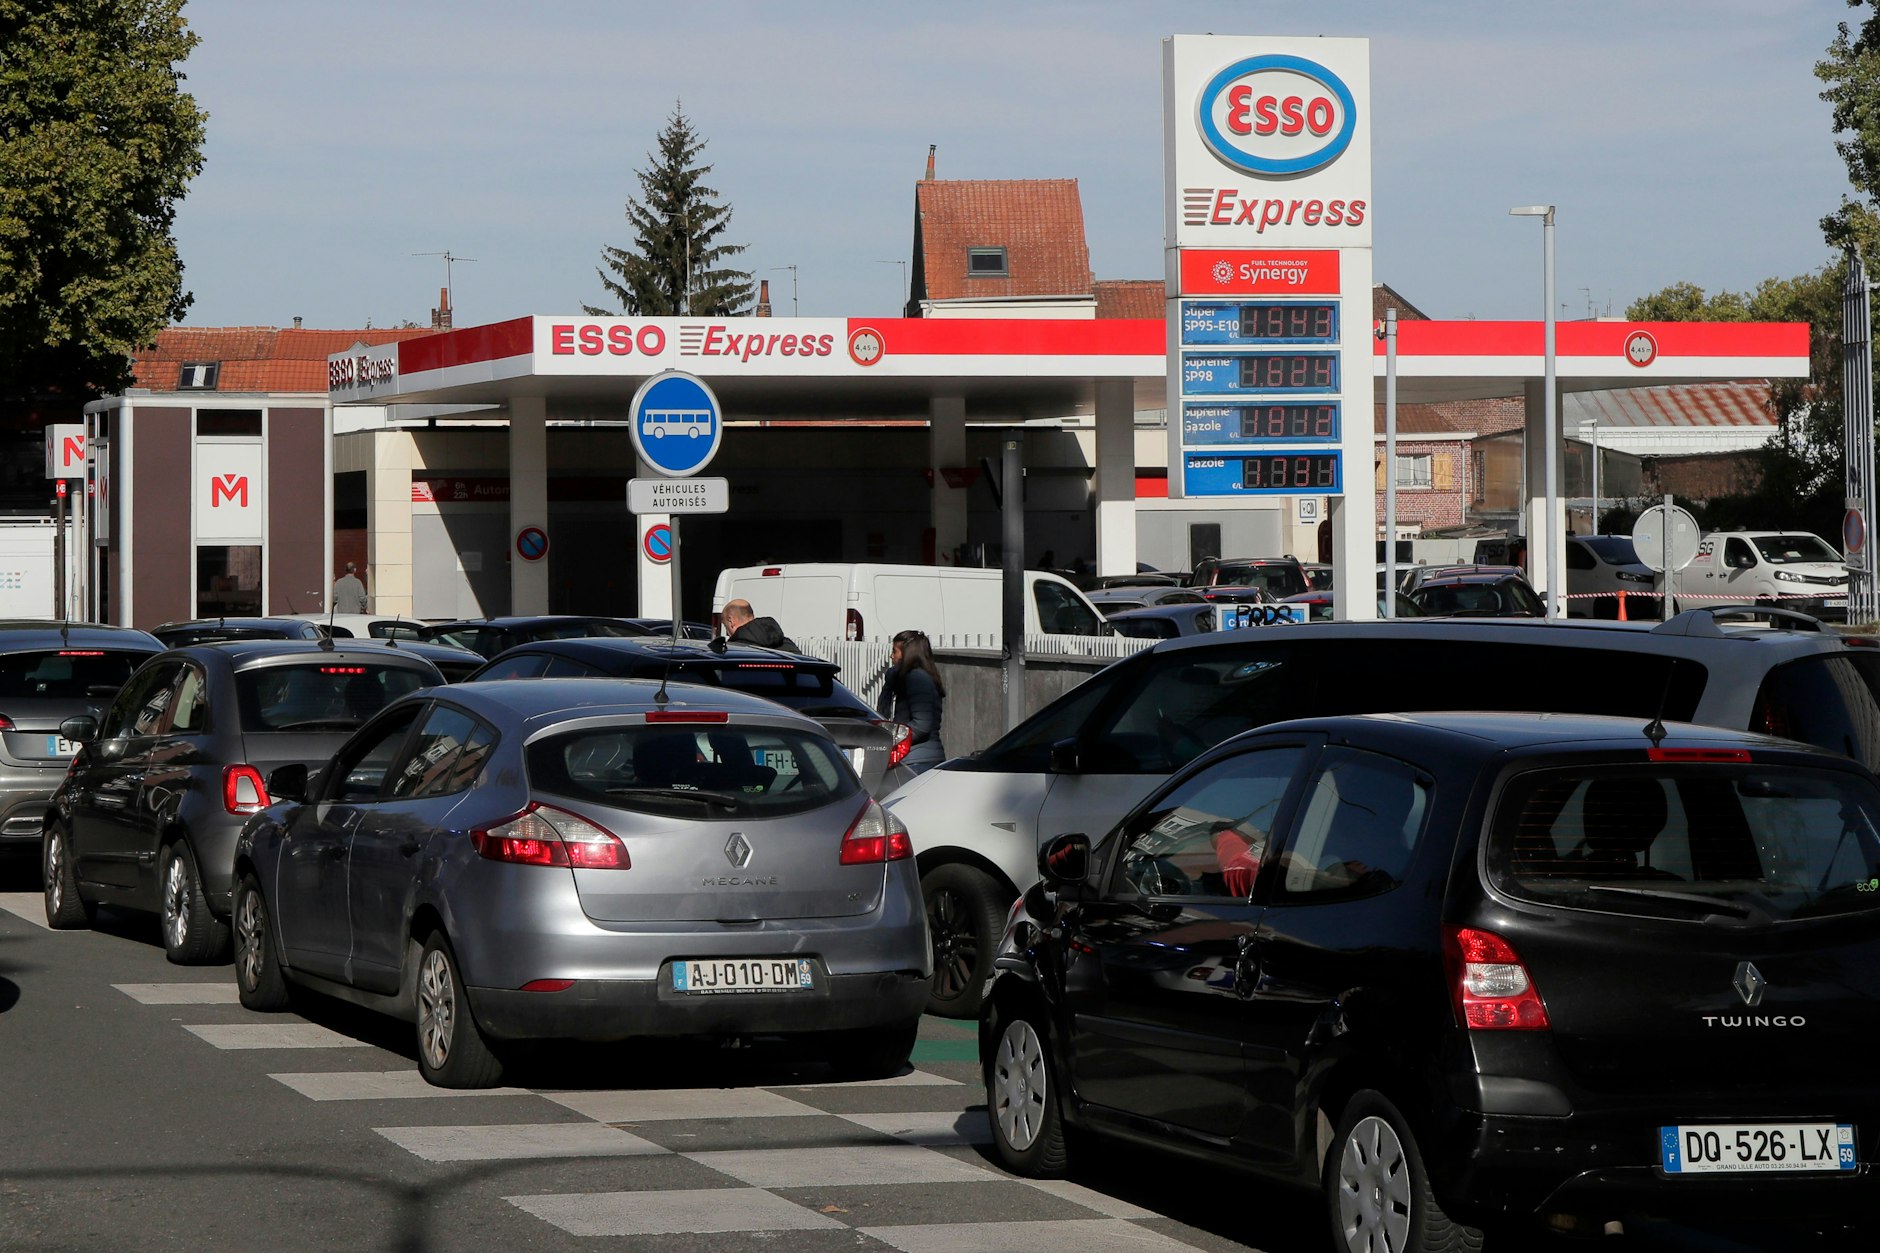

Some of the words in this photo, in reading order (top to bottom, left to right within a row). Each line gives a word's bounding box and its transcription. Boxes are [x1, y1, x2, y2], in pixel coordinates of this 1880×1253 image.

[1227, 85, 1335, 135] Esso
[1209, 189, 1366, 233] Express
[1239, 264, 1308, 285] Synergy
[1184, 320, 1240, 331] SP95-E10
[552, 325, 666, 356] ESSO
[701, 325, 834, 362] Express
[329, 357, 353, 386] ESSO
[360, 355, 393, 389] Express
[1185, 370, 1213, 382] SP98
[652, 484, 706, 494] VÉHICULES
[652, 496, 707, 507] AUTORISÉS
[800, 973, 812, 985] 59
[1702, 1016, 1806, 1027] TWINGO
[1685, 1129, 1833, 1162] DQ-526-LX
[1668, 1153, 1676, 1163] F
[1839, 1148, 1854, 1162] 59
